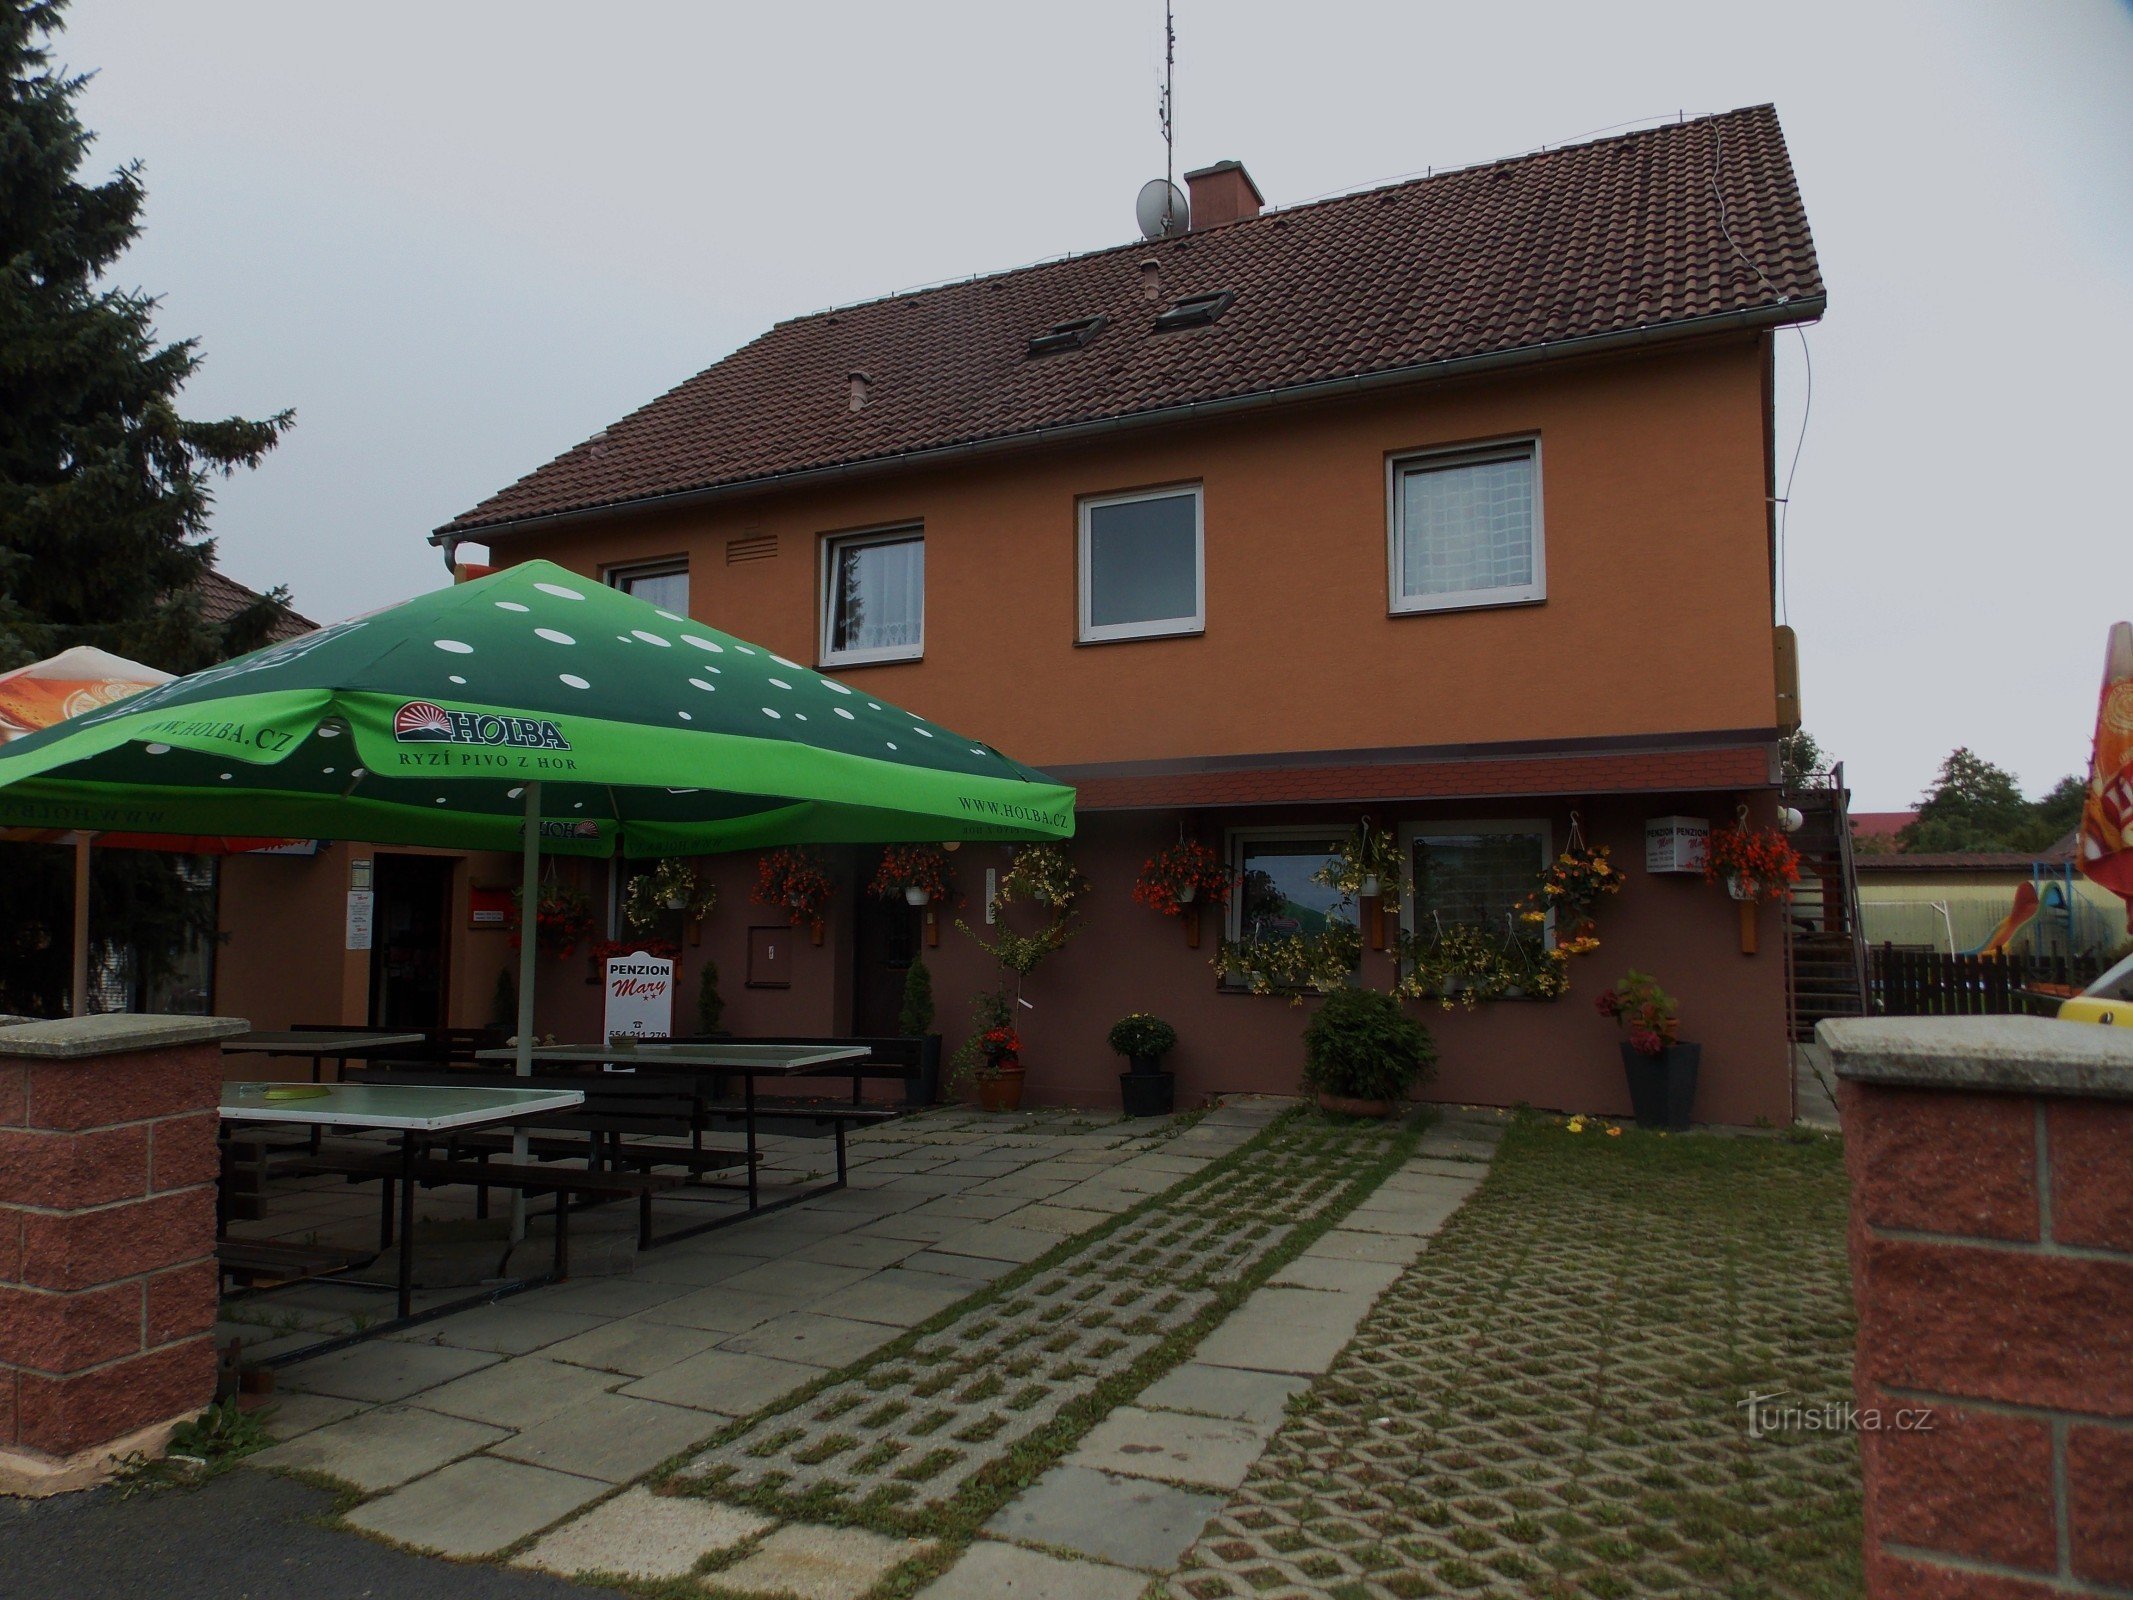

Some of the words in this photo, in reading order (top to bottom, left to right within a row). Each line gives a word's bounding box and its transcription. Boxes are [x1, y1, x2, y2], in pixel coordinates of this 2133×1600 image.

[444, 710, 572, 751] HOLBA
[399, 751, 450, 766] RYZÍ
[462, 753, 508, 767] PIVO
[517, 756, 529, 768] Z
[537, 757, 577, 770] HOR
[958, 797, 1068, 829] WWW.HOLBA.CZ
[1676, 827, 1708, 837] PENZION
[610, 964, 670, 976] PENZION
[612, 978, 667, 998] Mary
